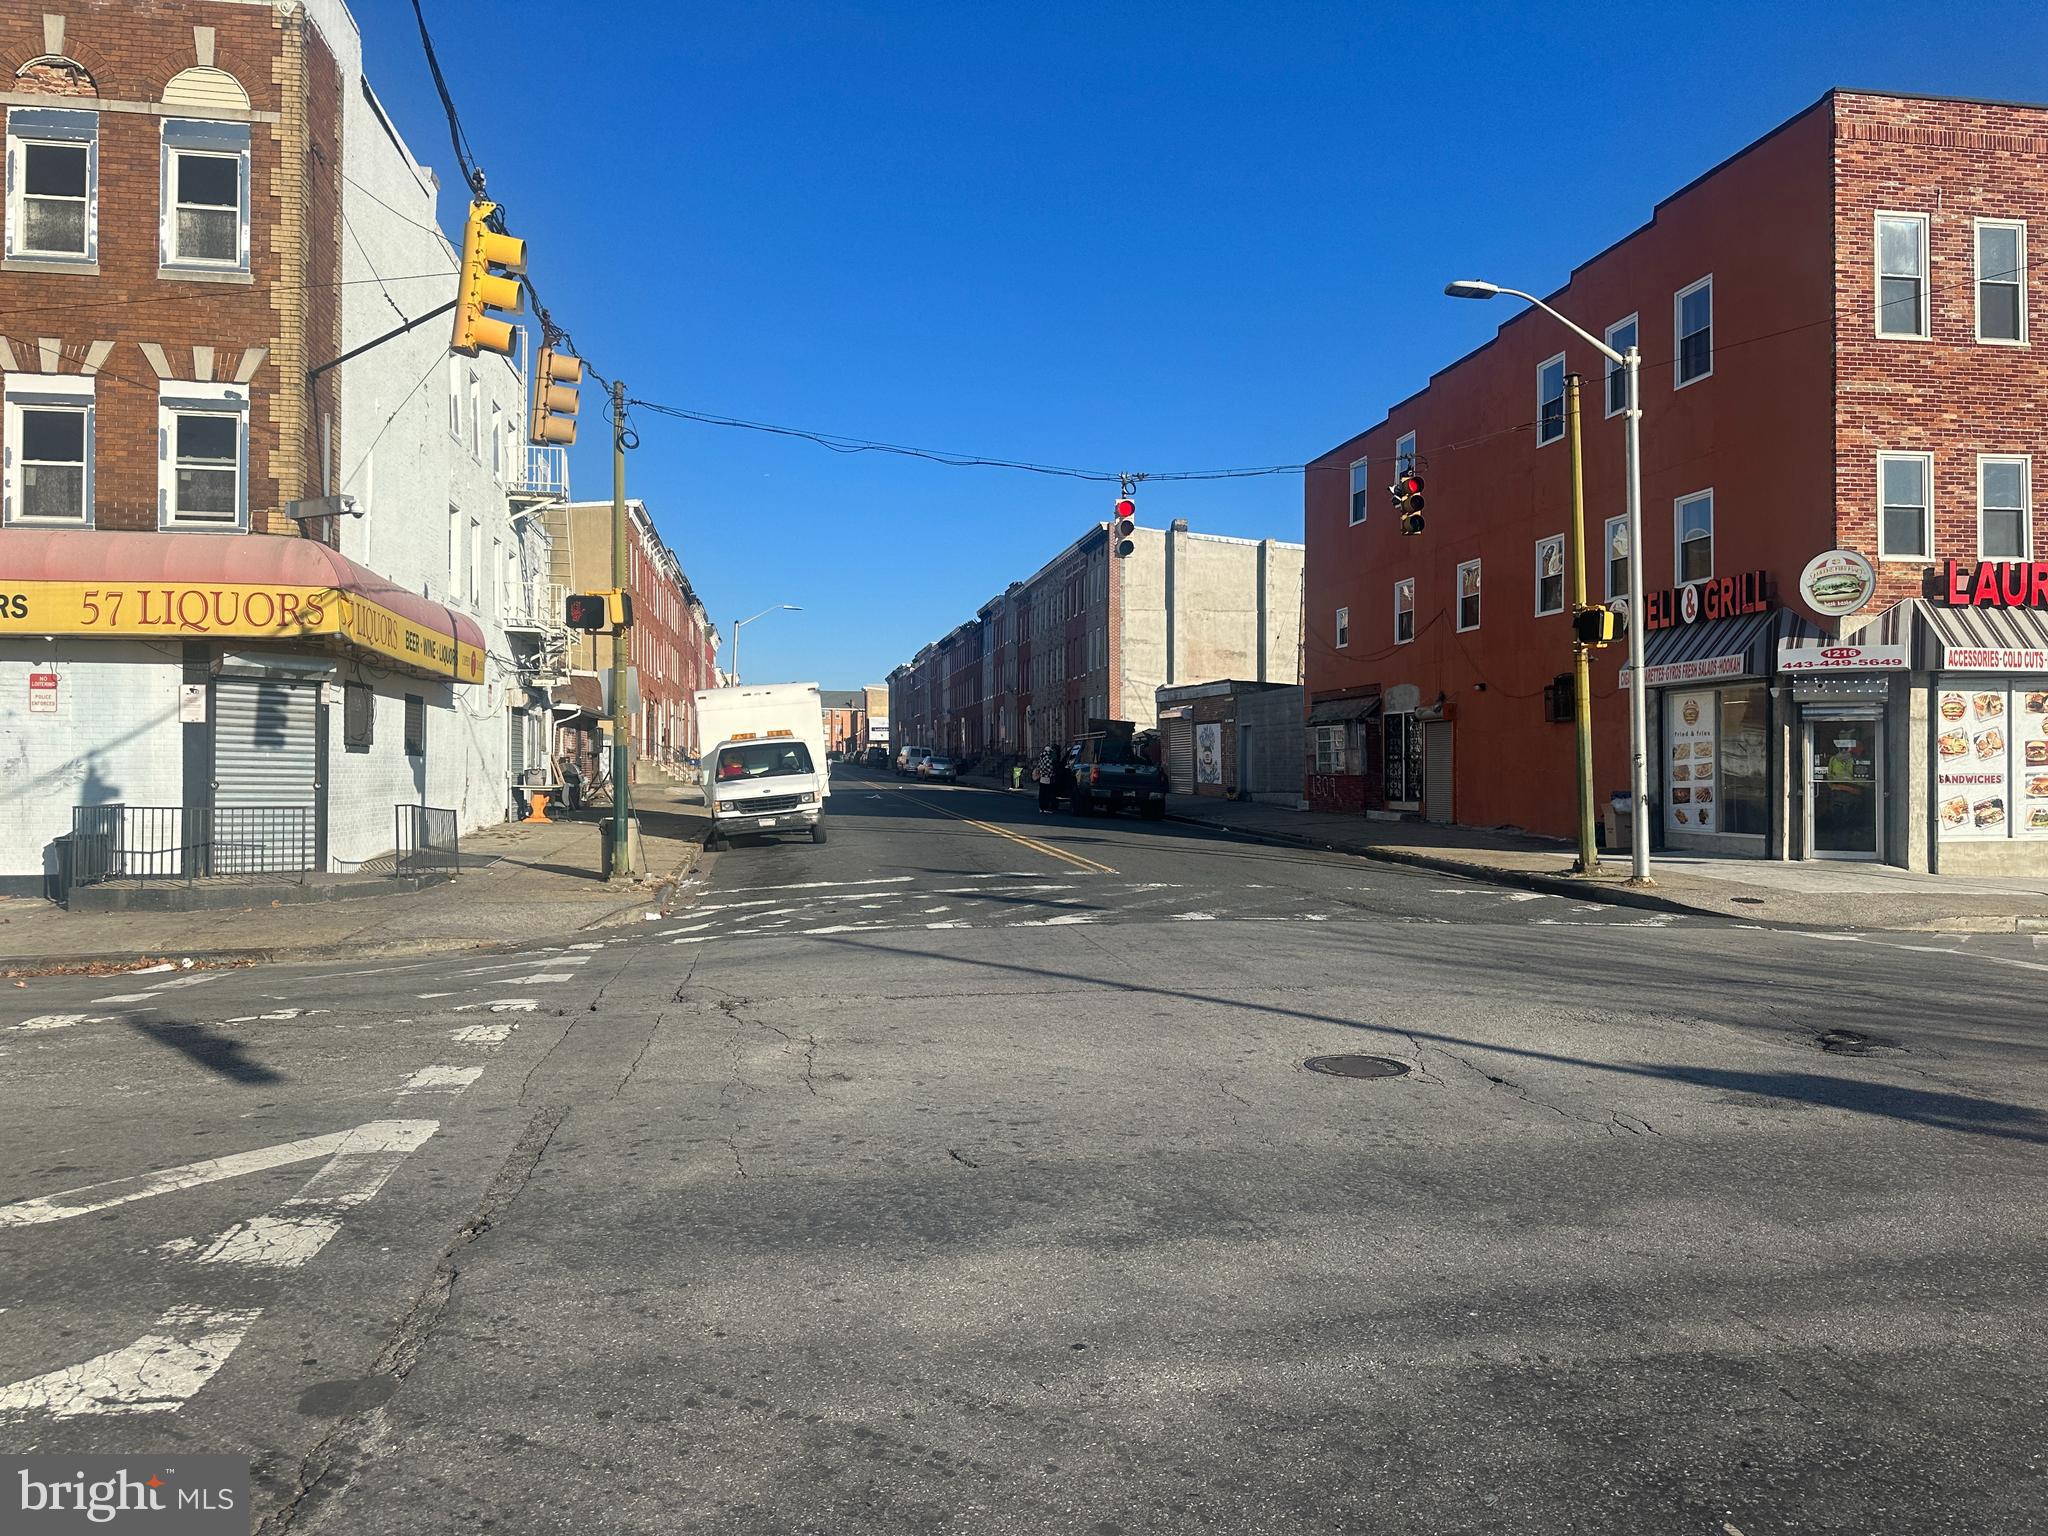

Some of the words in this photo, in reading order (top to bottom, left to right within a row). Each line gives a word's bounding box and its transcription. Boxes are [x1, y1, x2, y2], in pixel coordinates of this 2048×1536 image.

[80, 590, 124, 626] 57
[137, 590, 325, 633] LIQUORS
[1645, 588, 1675, 630] ELI
[1685, 588, 1696, 619] &
[1704, 570, 1767, 620] GRILL
[357, 603, 398, 650] LIQUORS
[405, 629, 420, 654] BEER
[423, 637, 436, 660] WINE
[1824, 649, 1857, 658] 1216
[1782, 658, 1903, 669] 443-449-5649
[1939, 775, 2001, 784] SANDWICHES
